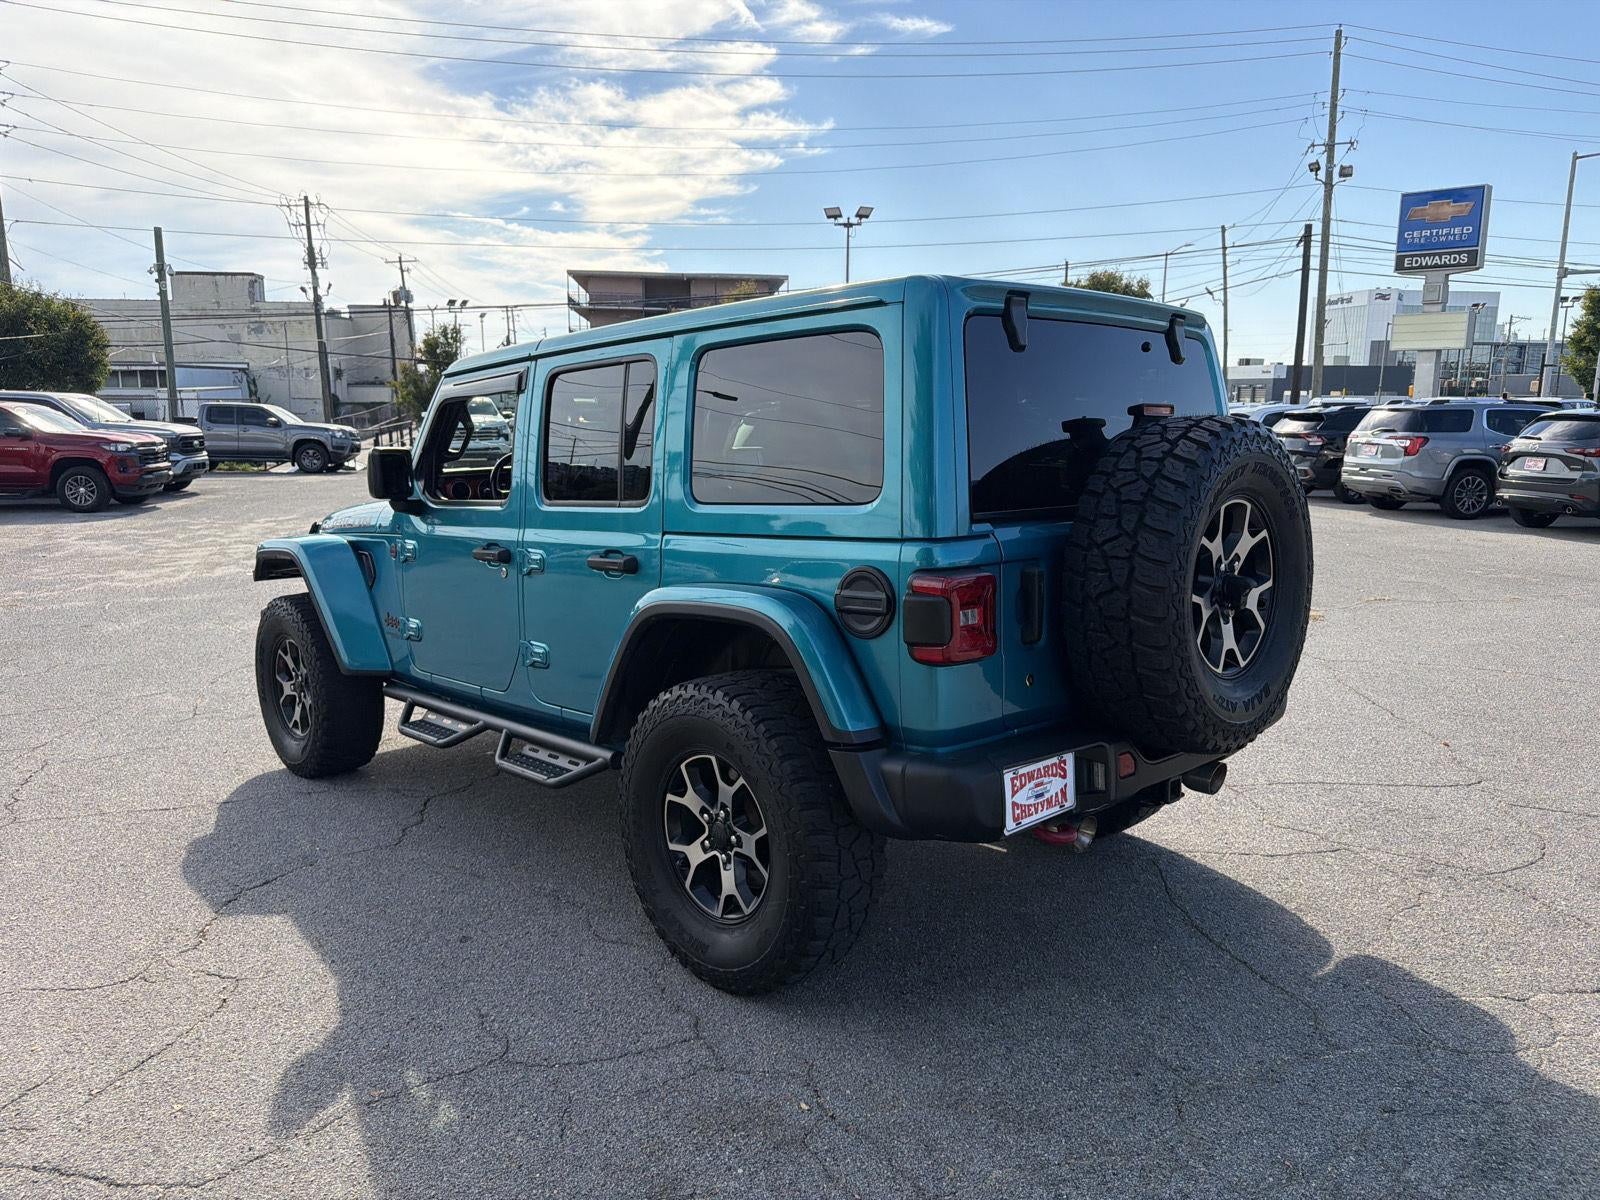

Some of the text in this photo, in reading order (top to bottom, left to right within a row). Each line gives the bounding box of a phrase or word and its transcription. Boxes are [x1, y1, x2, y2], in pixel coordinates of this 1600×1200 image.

[1404, 226, 1473, 238] CERTIFIED
[1407, 234, 1468, 244] PRE-OWNED
[1404, 253, 1468, 268] EDWARDS
[1010, 758, 1068, 798] EDWARDS
[1011, 782, 1068, 823] CHEVYMAN
